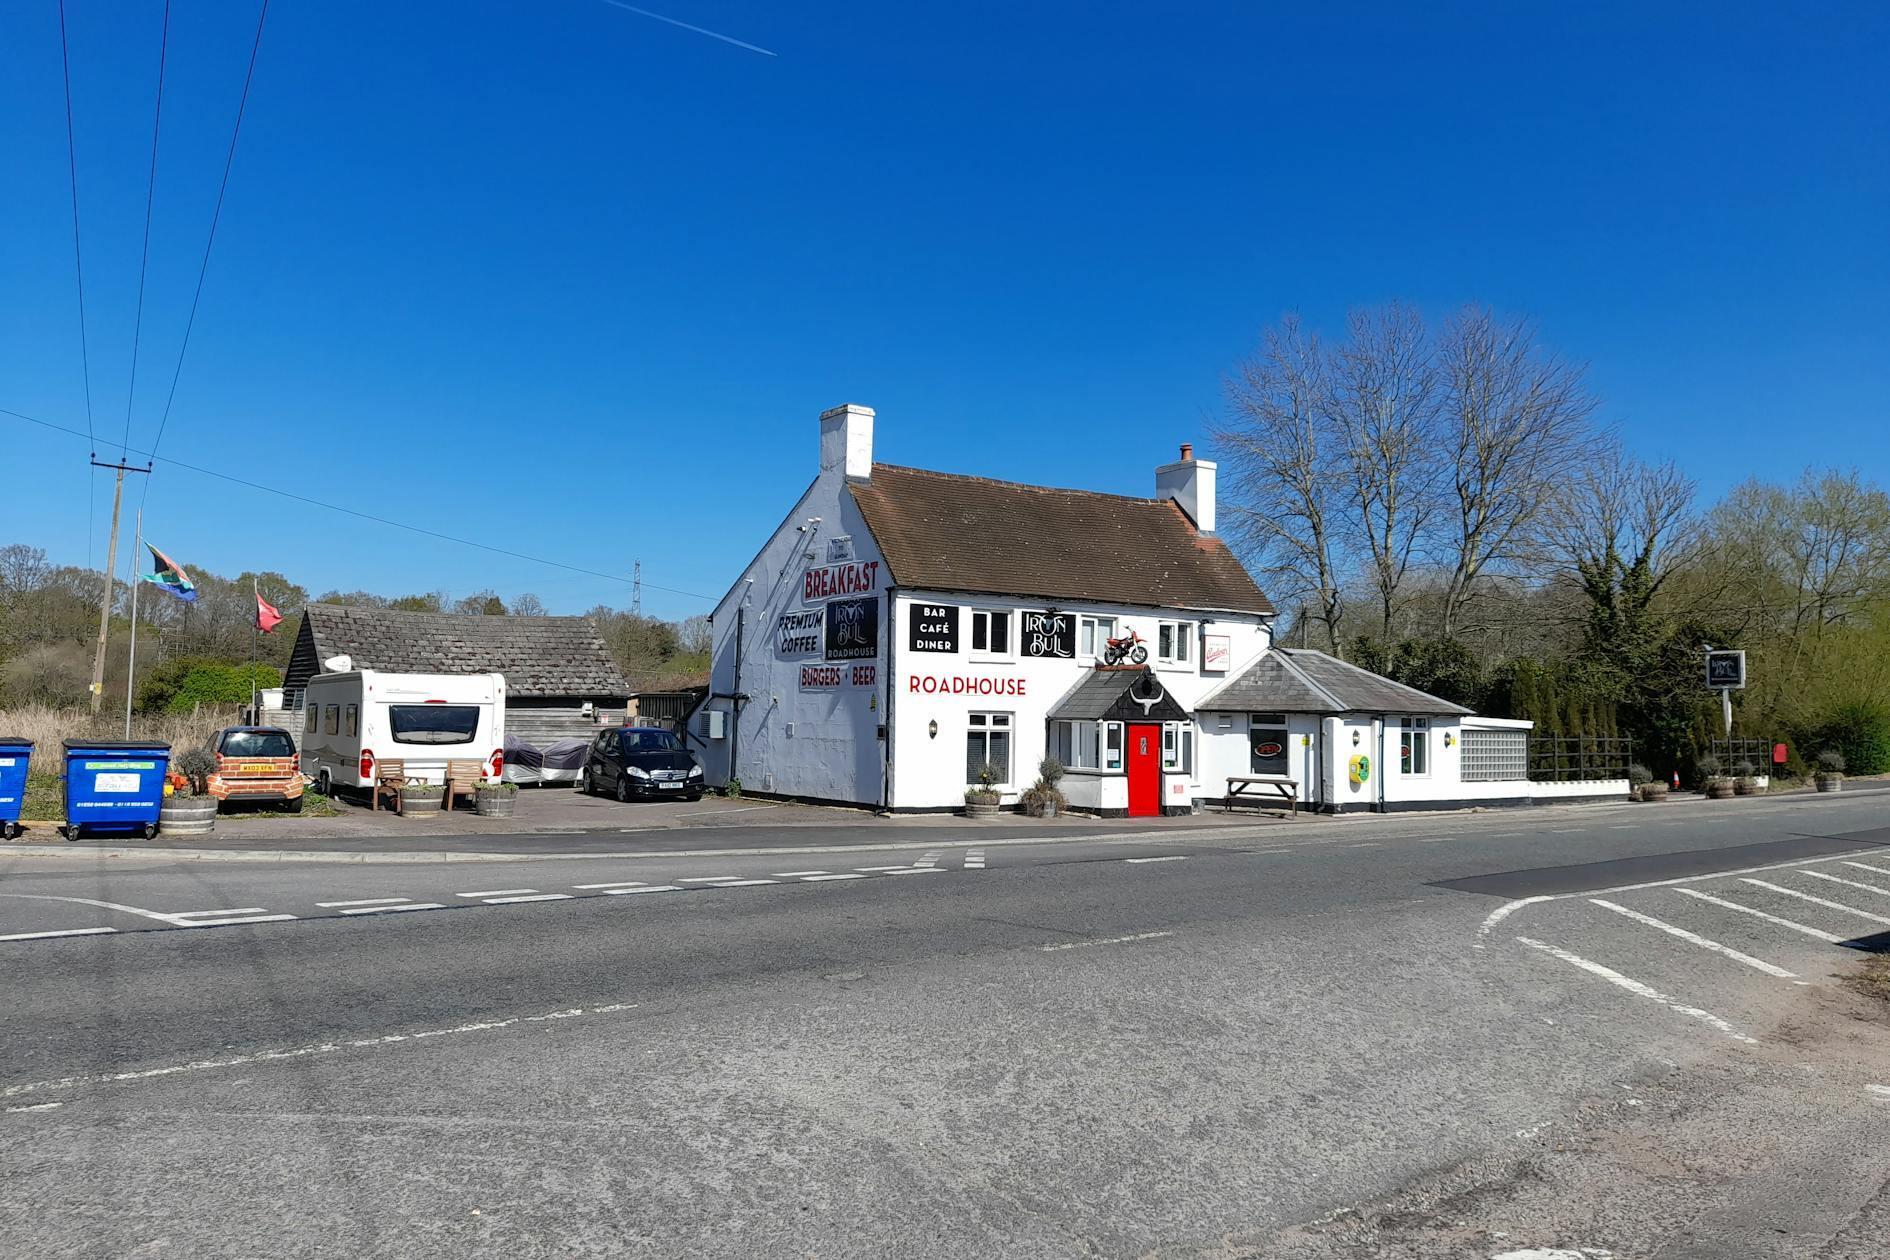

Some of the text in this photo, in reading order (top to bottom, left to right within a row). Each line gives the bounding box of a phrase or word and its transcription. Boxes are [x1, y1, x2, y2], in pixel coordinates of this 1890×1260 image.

[805, 561, 879, 598] BREAKFAST
[777, 611, 824, 632] PREMIUM
[835, 602, 865, 625] IRON
[923, 607, 946, 617] BAR
[837, 622, 868, 646] BULL
[919, 622, 949, 633] CAFÉ
[1025, 613, 1066, 636] IRON
[781, 635, 818, 653] COFFEE
[827, 646, 875, 658] ROADHOUSE
[916, 639, 952, 650] DINER
[1030, 633, 1072, 658] BULL
[801, 665, 876, 687] BURGERS BEER
[910, 675, 1026, 695] ROADHOUSE
